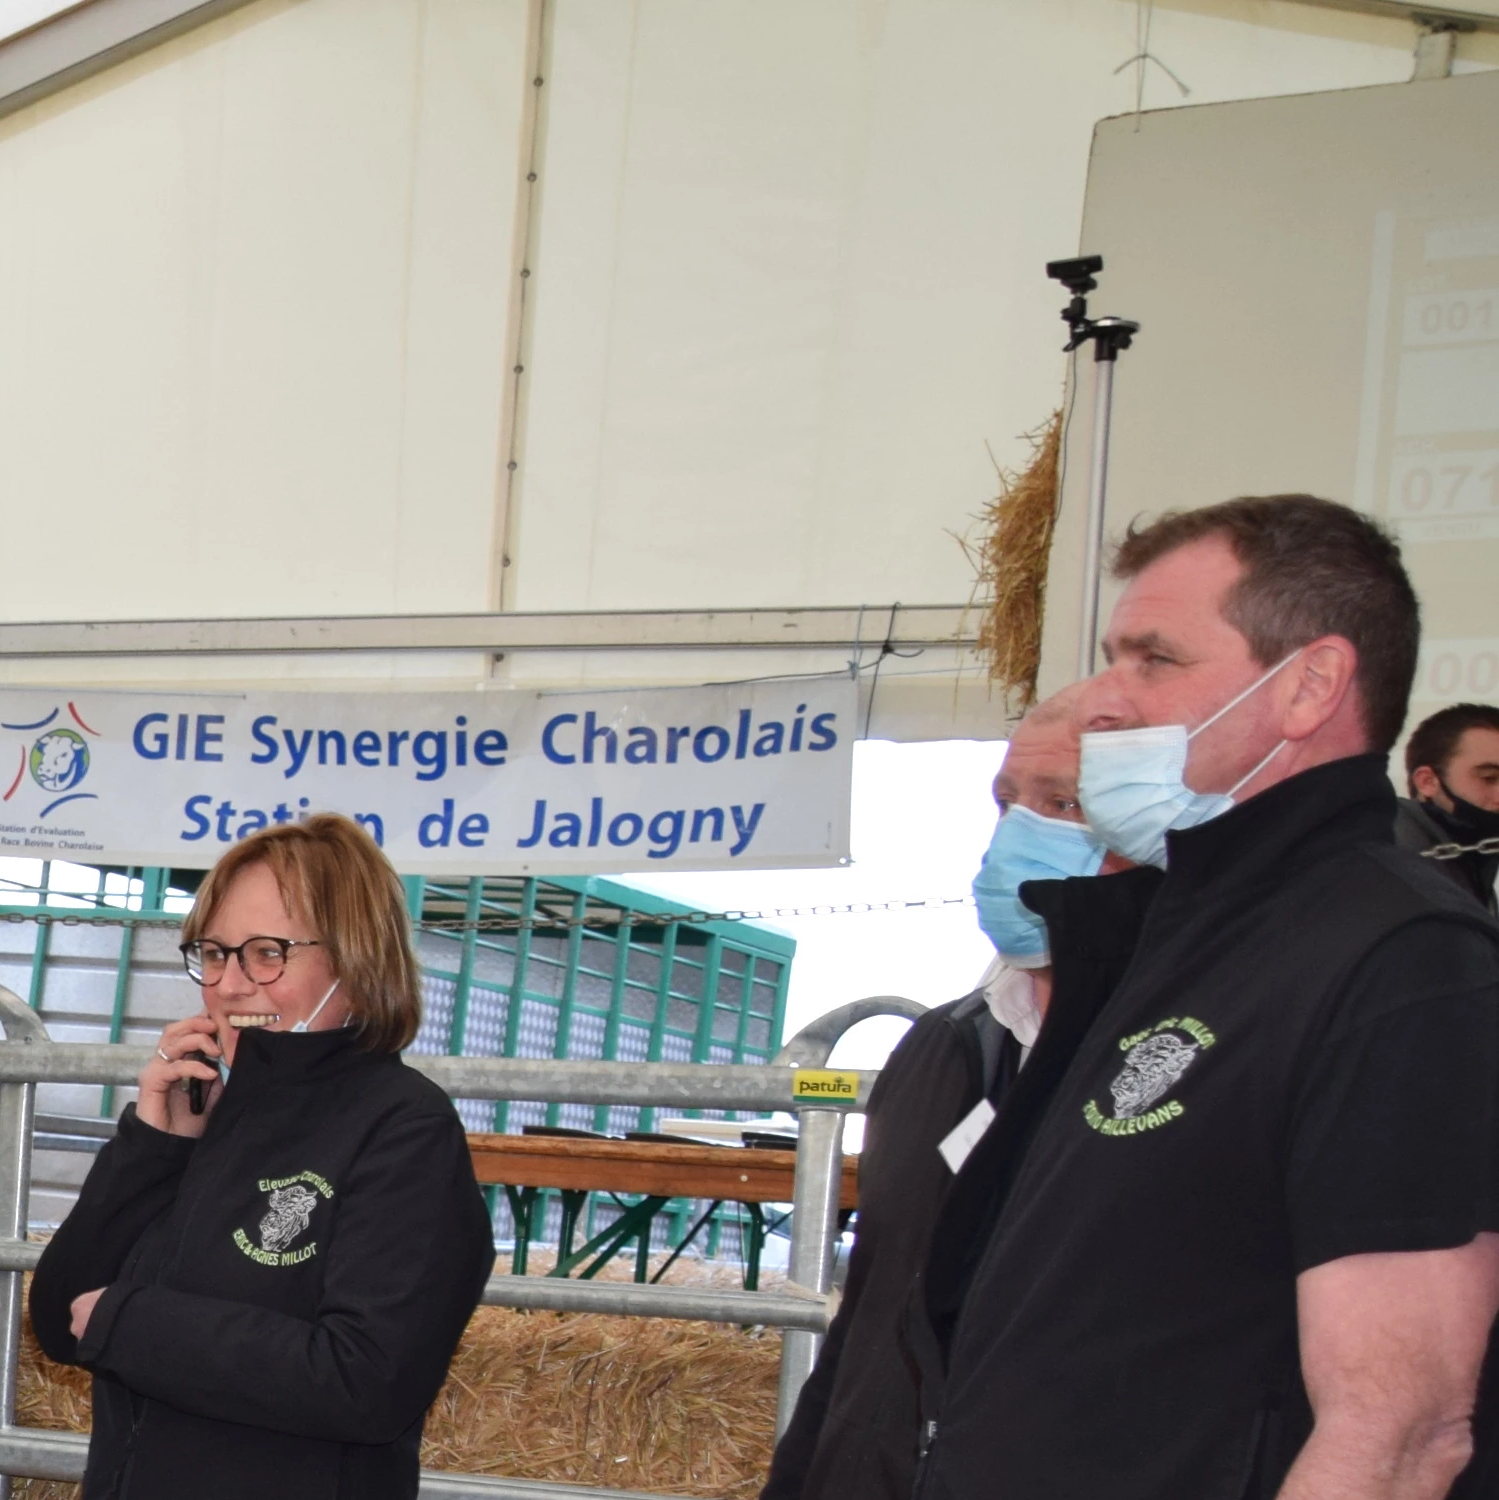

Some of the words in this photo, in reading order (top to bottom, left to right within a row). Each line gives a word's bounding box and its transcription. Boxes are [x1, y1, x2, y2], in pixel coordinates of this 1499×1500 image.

[133, 713, 225, 762] GIE
[251, 715, 508, 782] Synergie
[542, 704, 838, 765] Charolais
[31, 826, 85, 836] d'Evaluation
[181, 795, 384, 848] Statin
[418, 799, 490, 848] de
[517, 797, 766, 859] Jalogny
[1, 837, 20, 845] Race
[25, 839, 54, 848] Bovine
[58, 841, 104, 850] Charolaise
[799, 1080, 851, 1094] patura
[282, 1243, 317, 1265] MILLOT
